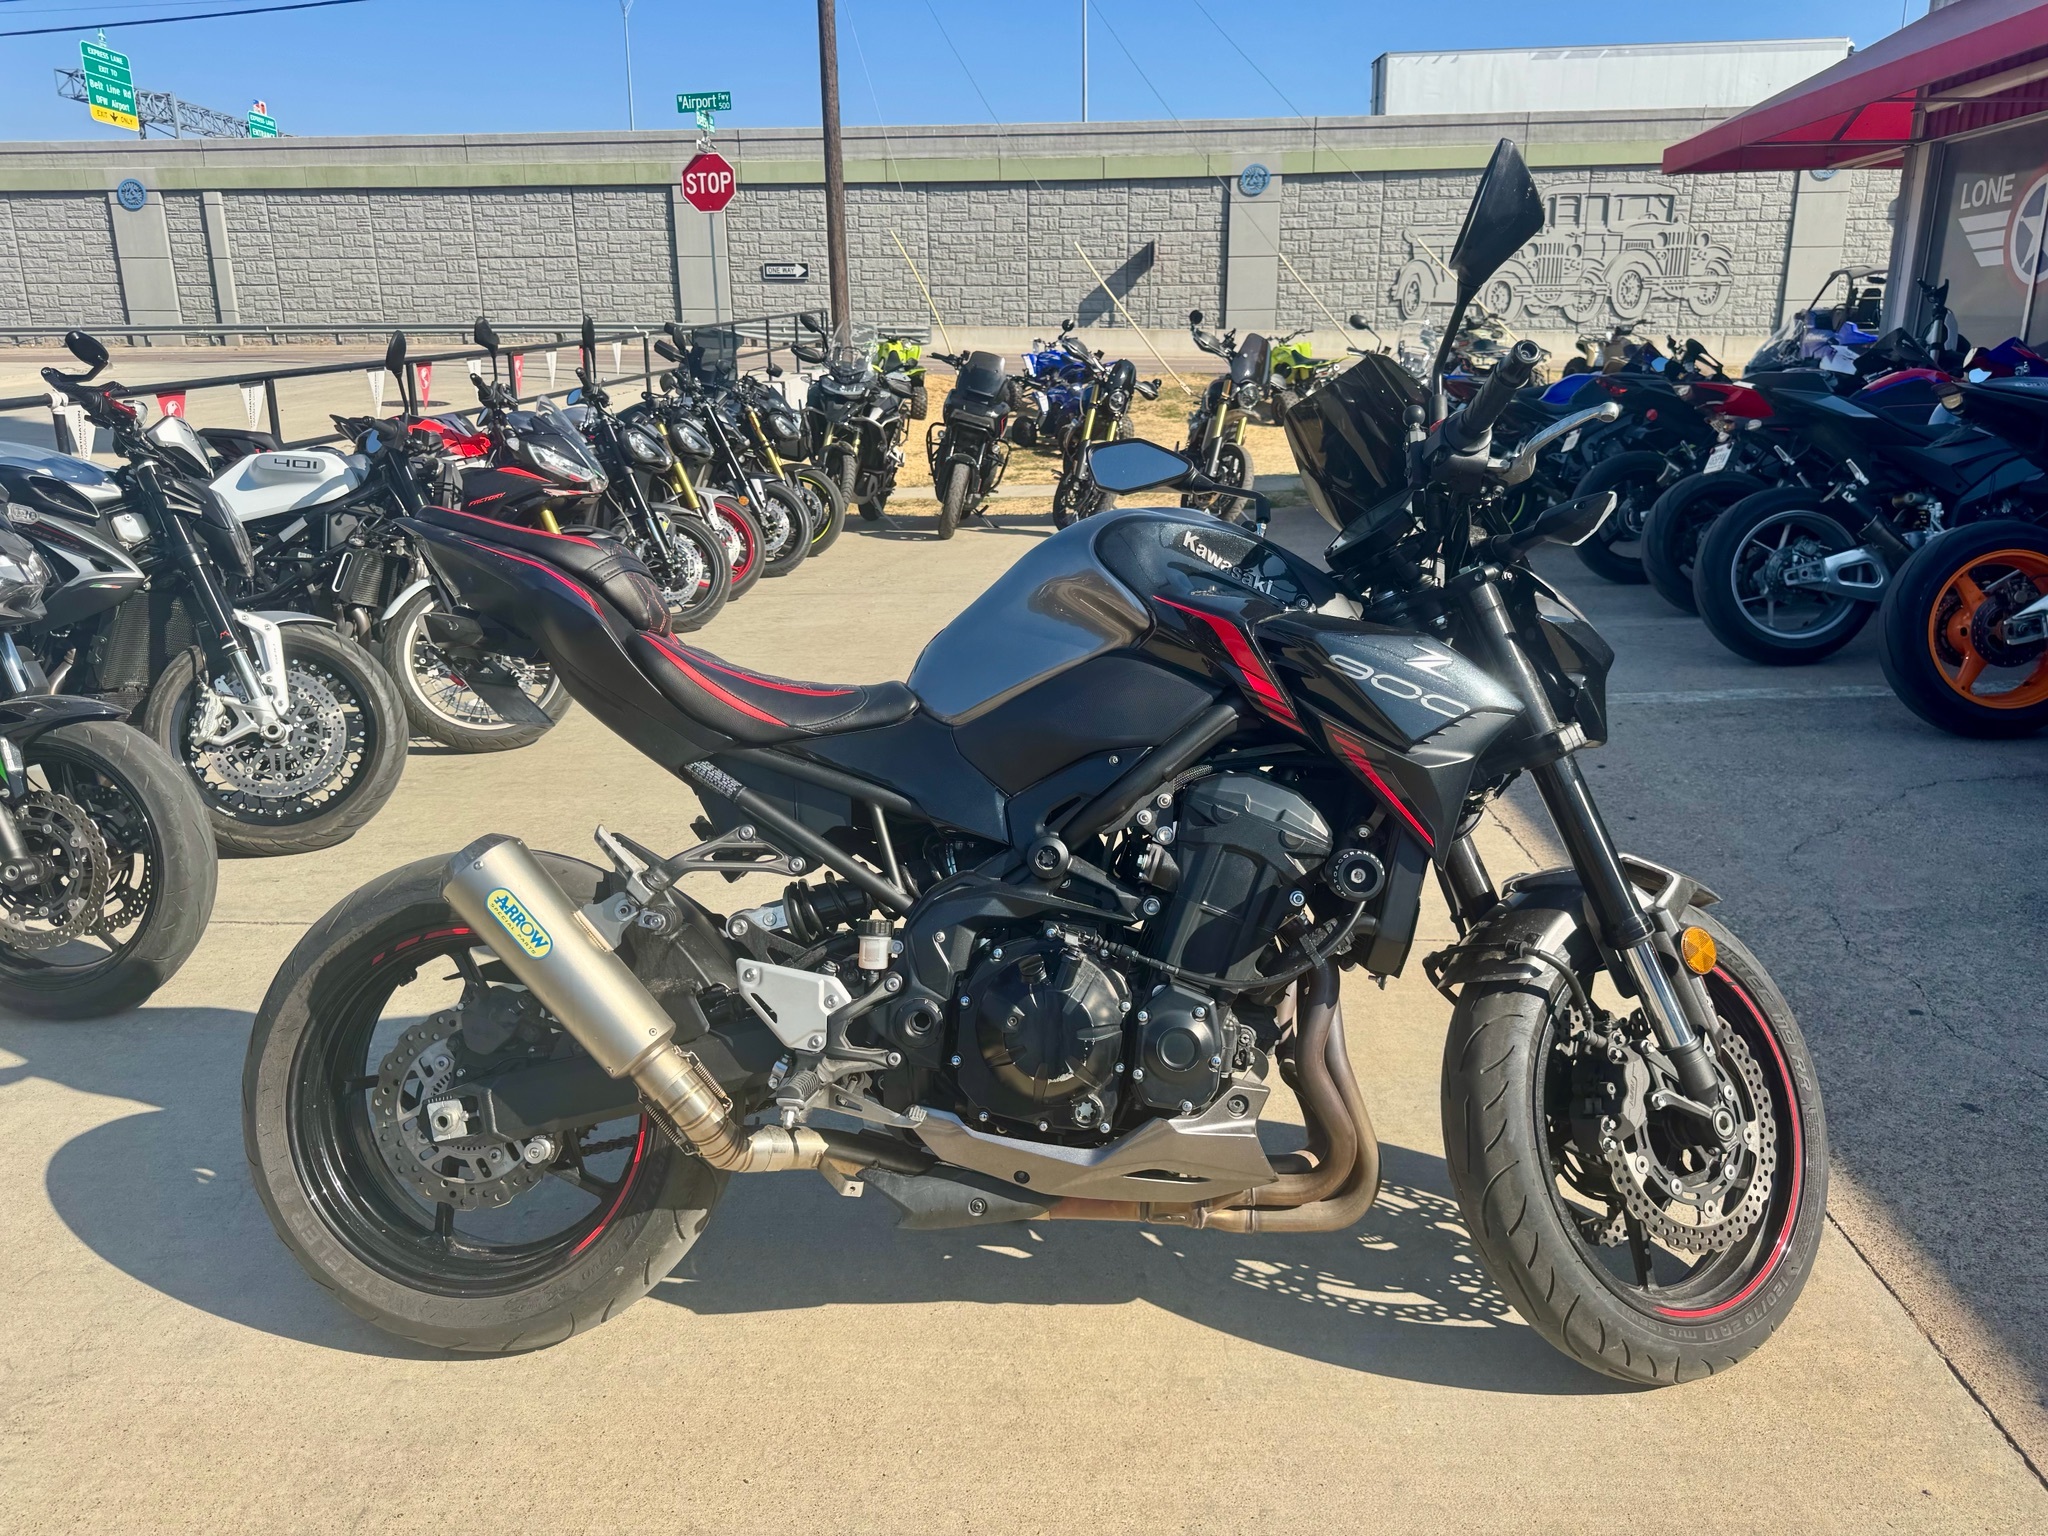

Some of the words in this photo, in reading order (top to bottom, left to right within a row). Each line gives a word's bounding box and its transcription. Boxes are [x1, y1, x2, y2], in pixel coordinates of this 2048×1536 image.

[87, 46, 109, 60] EXPRESS
[110, 54, 124, 65] LANE
[98, 65, 109, 74] EXIT
[110, 68, 118, 77] TO
[89, 78, 104, 91] Belt
[106, 84, 121, 96] Line
[122, 88, 132, 99] Rd
[95, 94, 108, 105] DFW
[111, 99, 131, 112] Airport
[682, 94, 717, 111] Airport
[718, 93, 729, 102] Fwy
[718, 101, 731, 110] 500
[97, 110, 108, 118] EXIT
[120, 116, 133, 125] ONLY
[686, 171, 732, 195] STOP
[1960, 173, 2016, 210] LONE
[767, 266, 781, 274] ONE
[781, 266, 796, 274] WAY
[274, 457, 317, 469] 401
[468, 491, 507, 507] FACTORY
[1182, 530, 1274, 596] Kawasaki
[1403, 643, 1454, 682] Z
[1328, 653, 1471, 719] 900
[490, 902, 516, 932] SPECIAL
[517, 933, 537, 955] PARTS
[494, 895, 549, 949] ARROW
